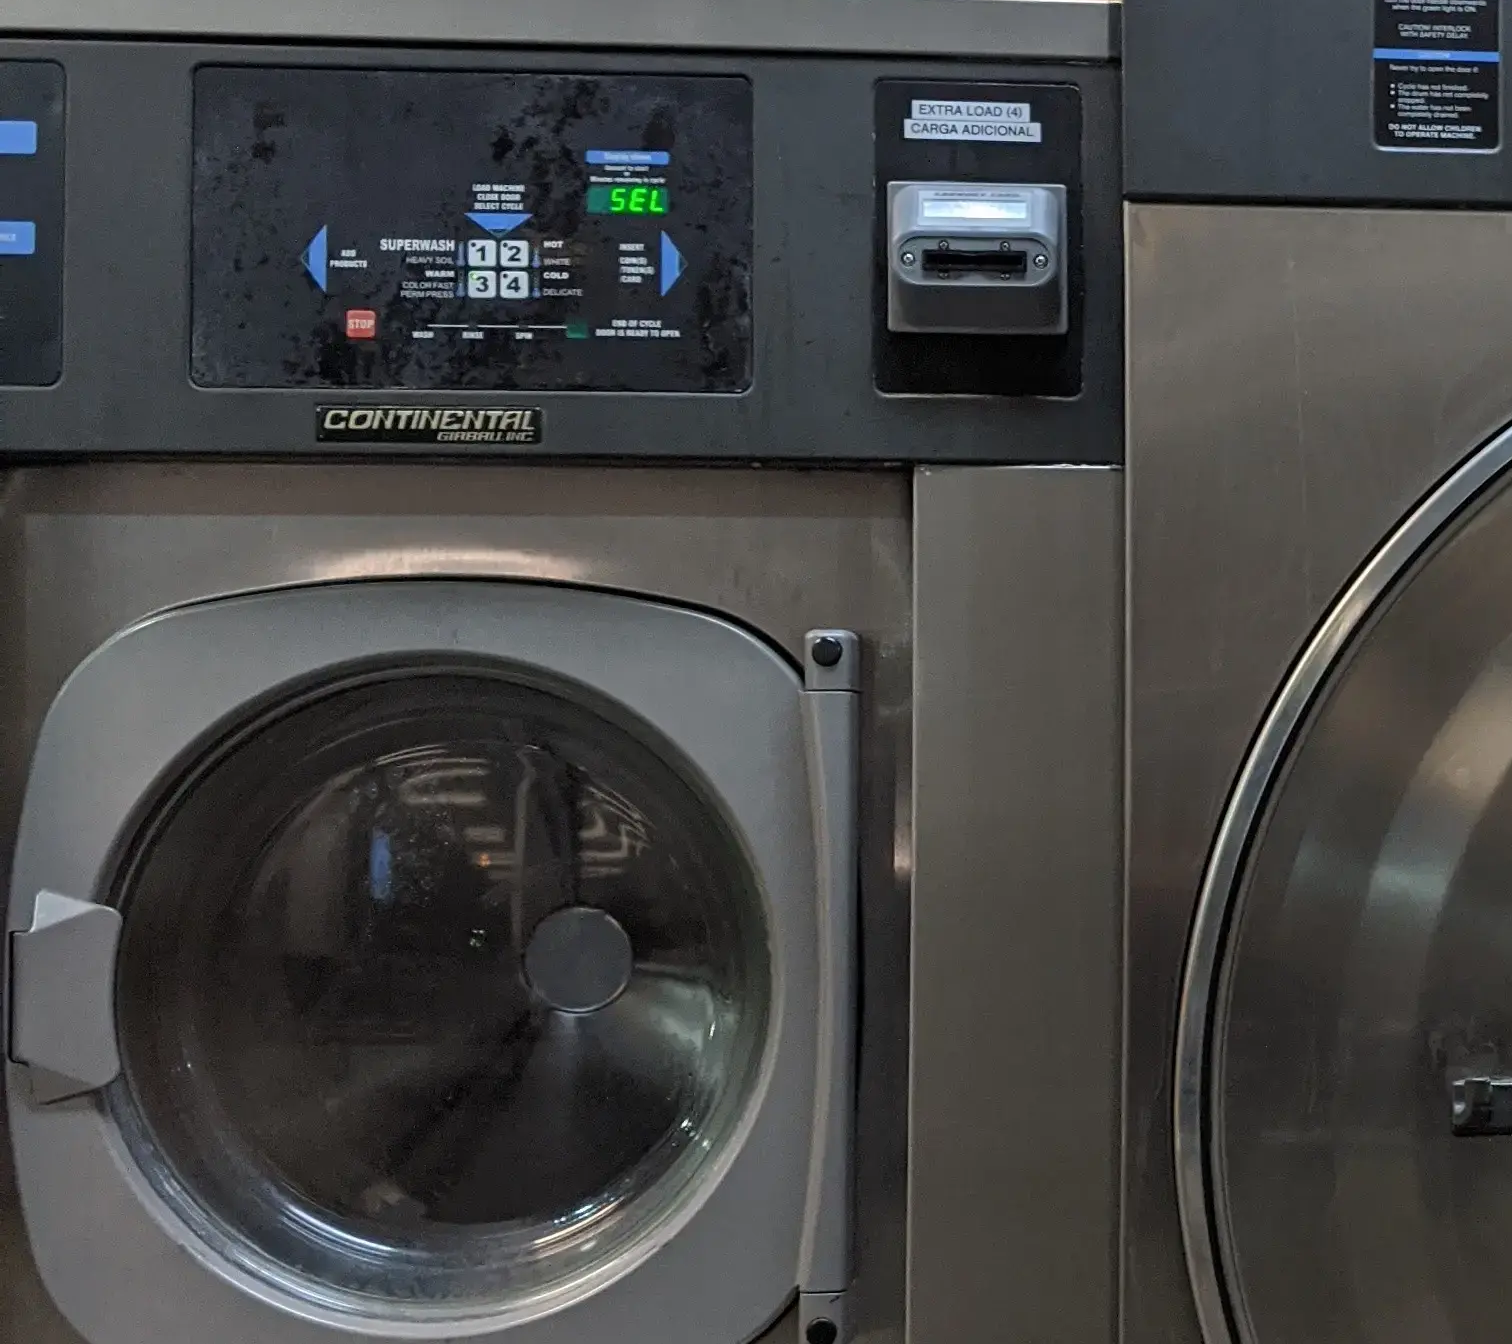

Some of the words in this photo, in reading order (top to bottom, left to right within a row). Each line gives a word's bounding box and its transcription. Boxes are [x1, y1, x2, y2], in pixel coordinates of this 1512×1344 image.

[919, 106, 962, 116] EXTRA
[966, 106, 1003, 117] LOAD
[1006, 107, 1022, 119] (4)
[911, 123, 957, 135] CARGA
[962, 125, 1033, 137] ADICIONAL
[472, 184, 490, 192] LOAD
[611, 188, 664, 212] SEL
[380, 239, 455, 251] SUPERWASH
[330, 260, 368, 268] PRODUCTS
[433, 257, 454, 265] SOIL
[543, 272, 569, 280] COLD
[402, 281, 431, 289] COLOR
[400, 290, 425, 298] PERM
[348, 319, 375, 329] STOP
[639, 320, 662, 328] CYCLE
[323, 409, 535, 430] CONTINENTAL
